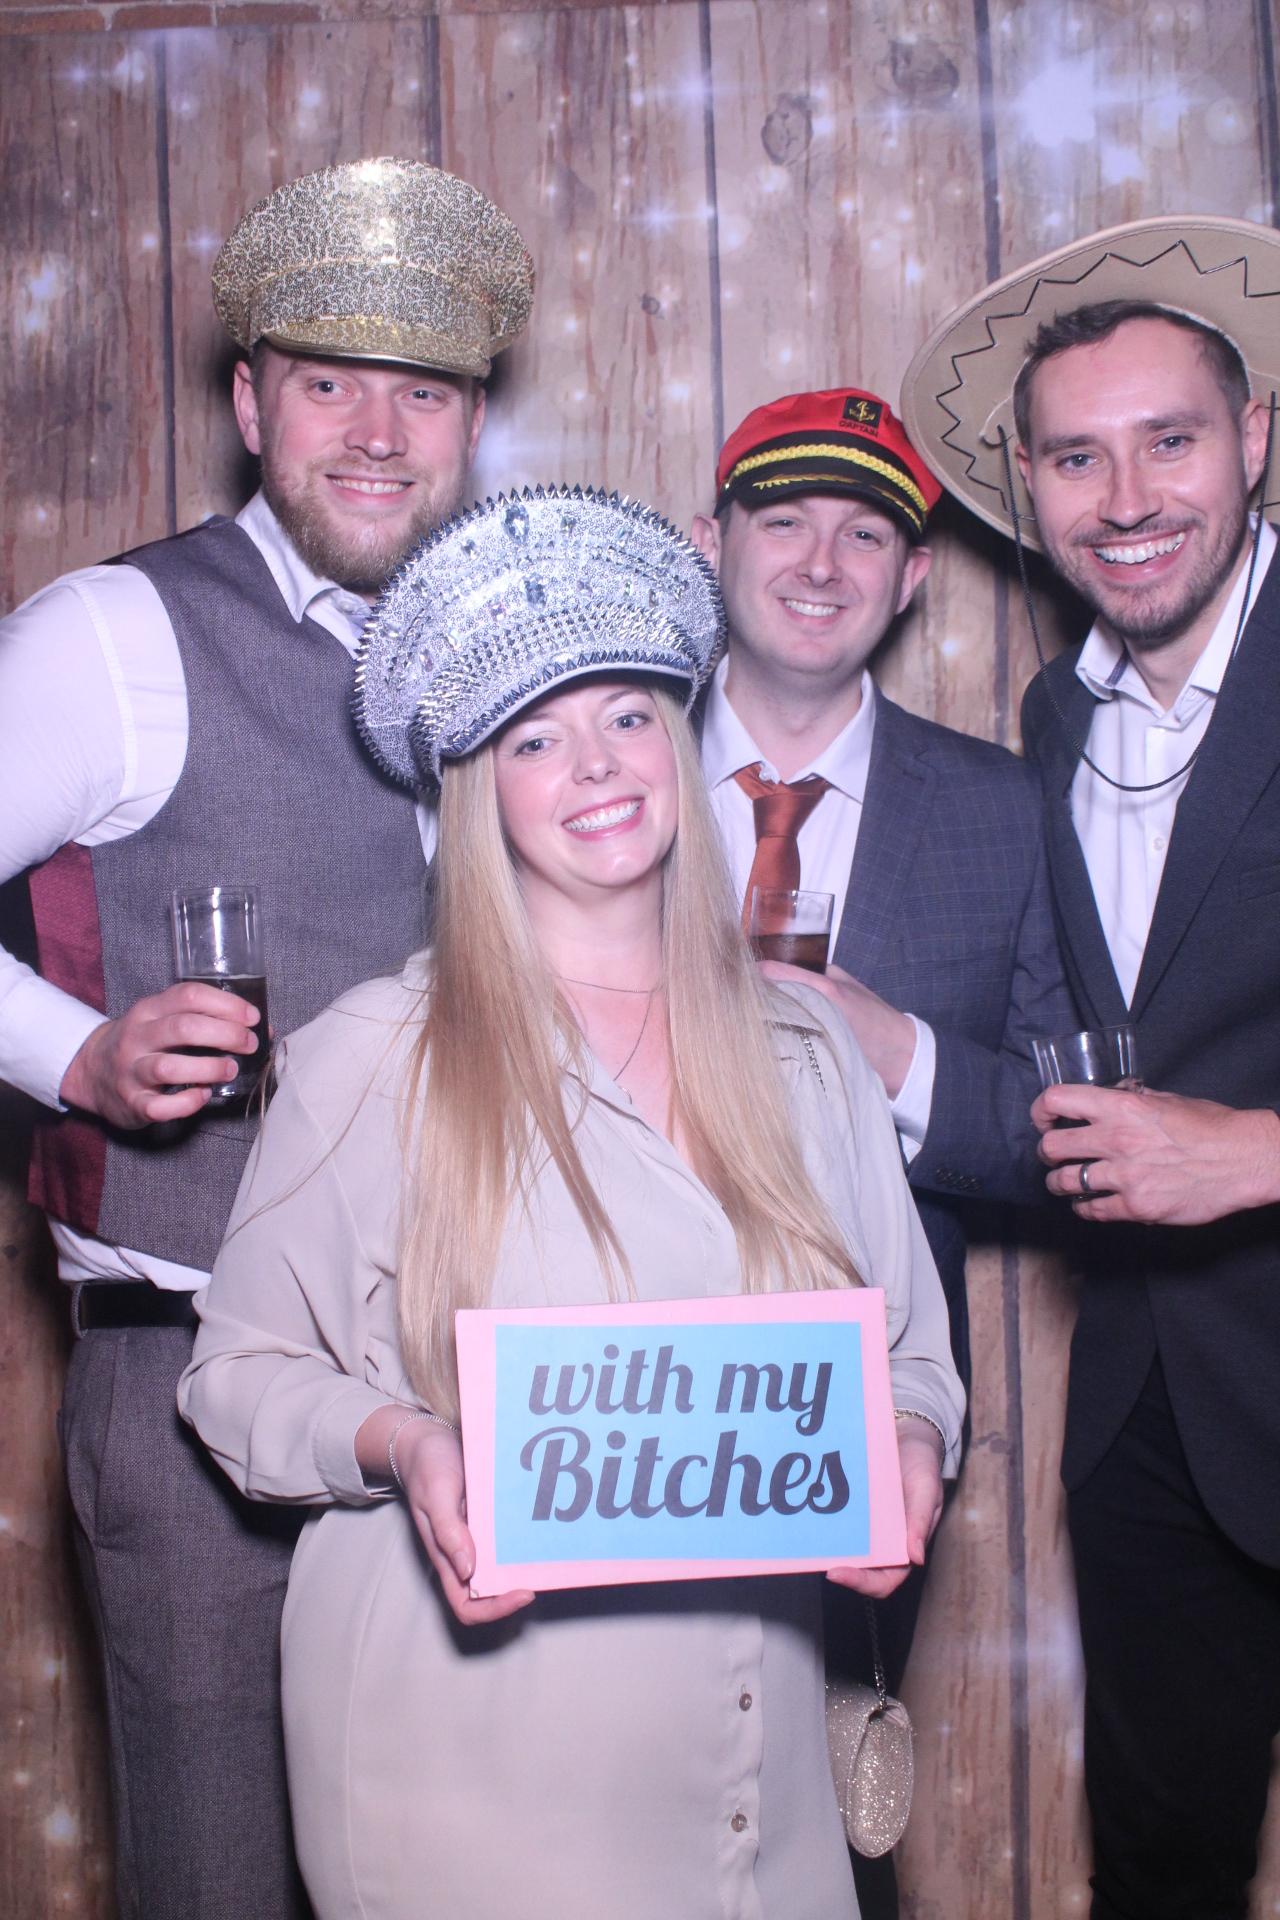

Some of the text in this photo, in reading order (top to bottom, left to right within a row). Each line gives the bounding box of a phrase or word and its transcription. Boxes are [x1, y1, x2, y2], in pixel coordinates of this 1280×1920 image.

[839, 420, 879, 437] CAPTAIN
[528, 1344, 833, 1436] with my
[519, 1426, 850, 1523] Bitches
